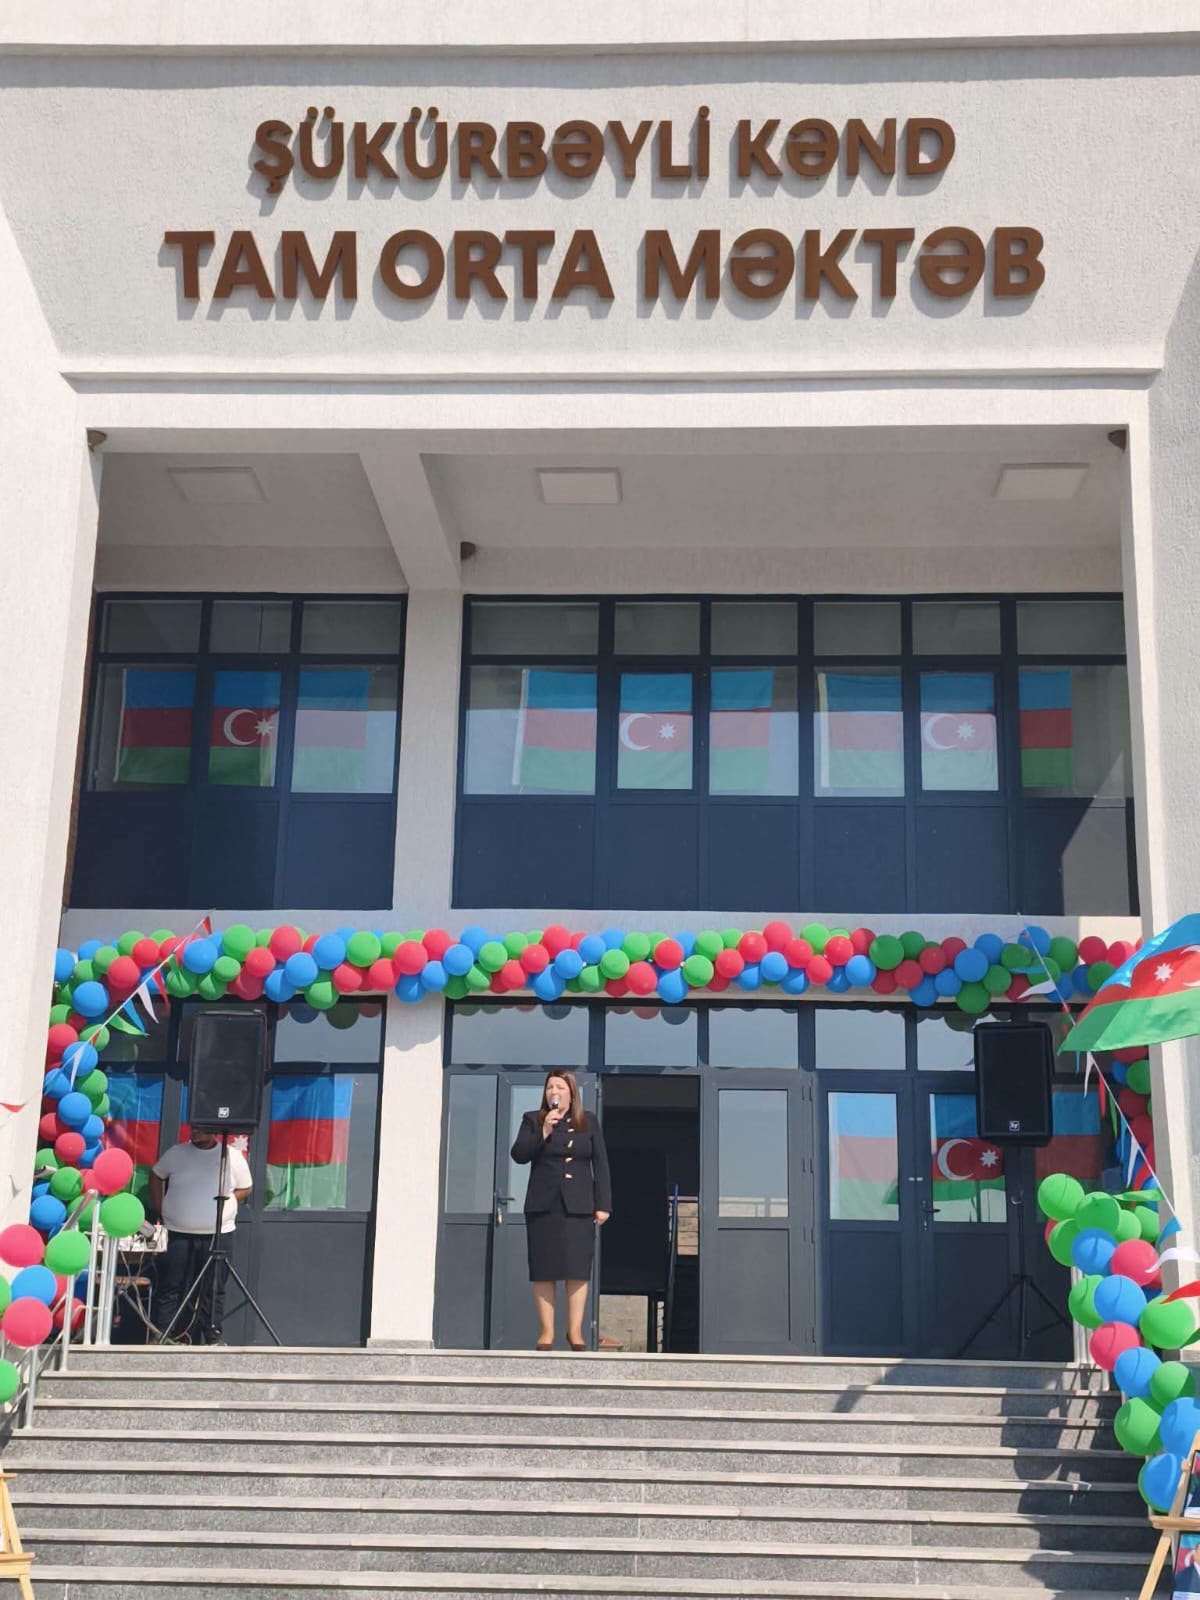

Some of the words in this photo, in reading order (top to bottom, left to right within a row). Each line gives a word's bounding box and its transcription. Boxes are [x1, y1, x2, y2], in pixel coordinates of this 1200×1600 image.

[255, 105, 711, 194] ŞÜKÜRBƏYLİ
[737, 117, 956, 177] KƏND
[163, 230, 358, 302] TAM
[379, 229, 615, 302] ORTA
[644, 226, 1046, 302] MƏKTƏB
